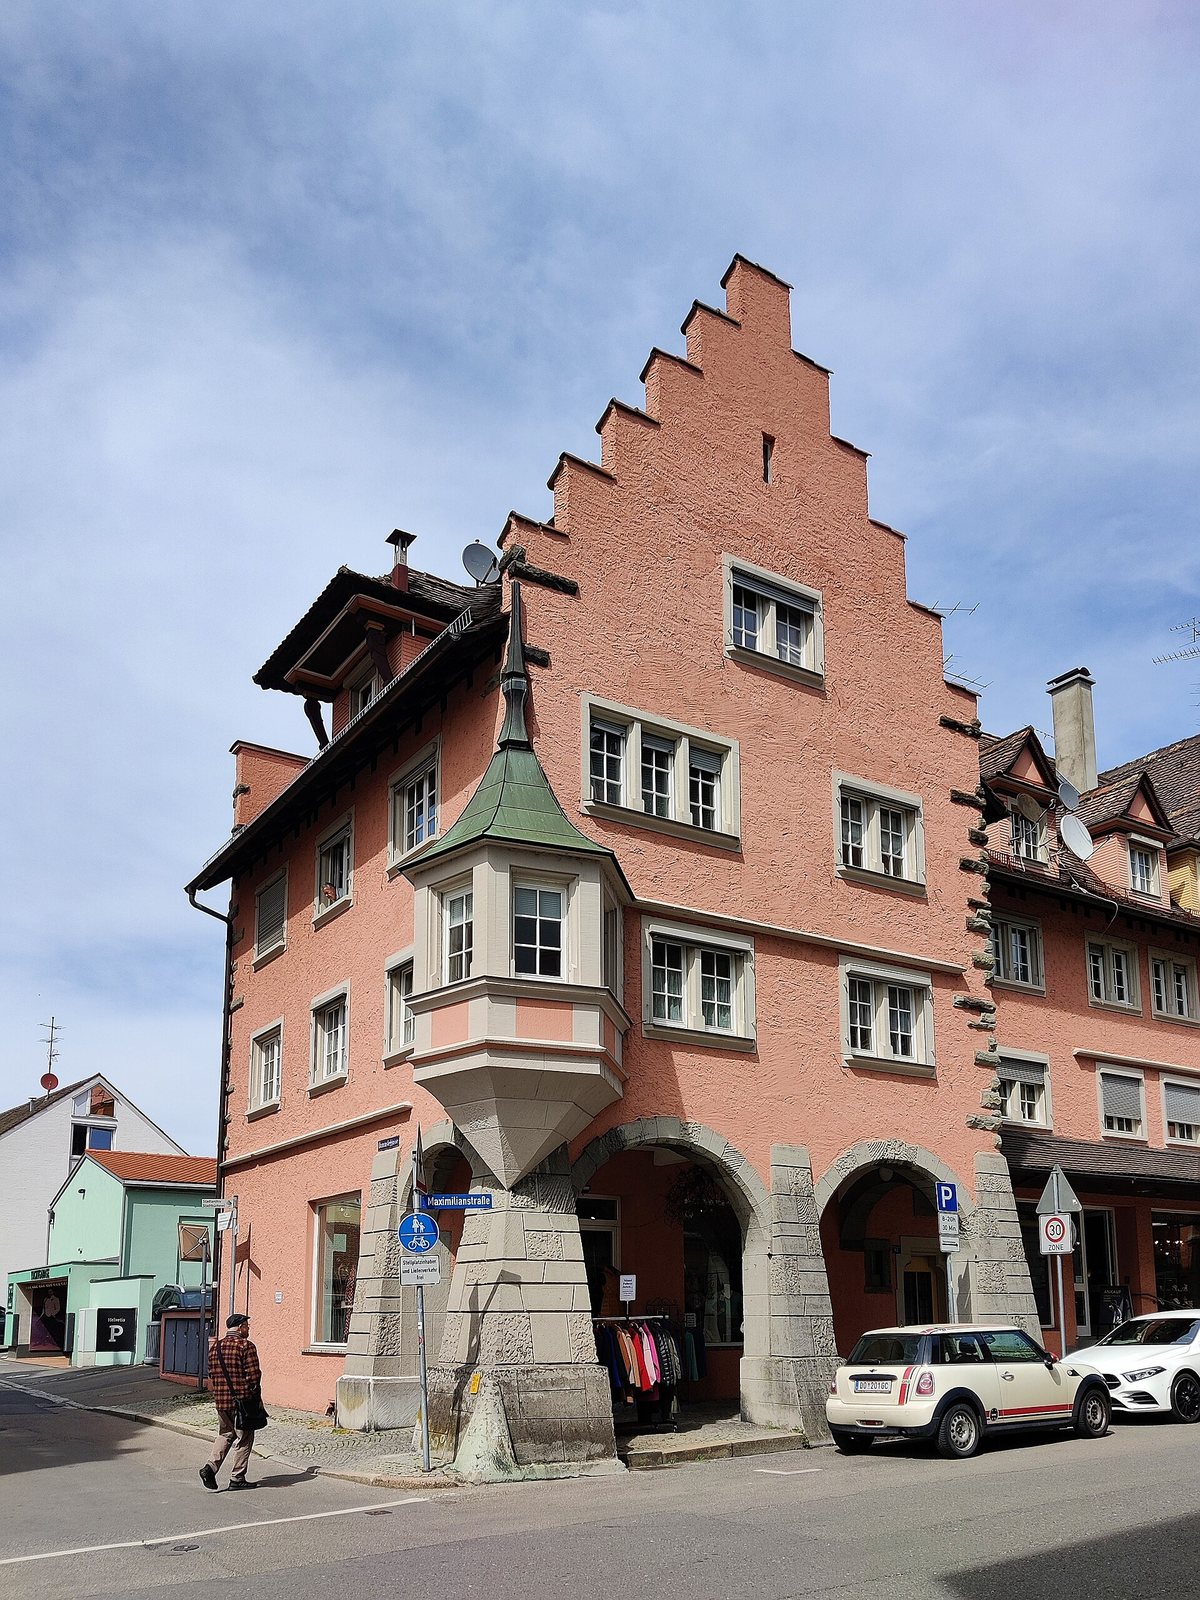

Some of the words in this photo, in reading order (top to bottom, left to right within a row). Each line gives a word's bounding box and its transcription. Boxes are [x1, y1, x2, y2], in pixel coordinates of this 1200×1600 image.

[427, 1195, 490, 1206] Maximilianstraße
[941, 1185, 953, 1208] P
[1049, 1224, 1062, 1236] 30
[108, 1324, 124, 1342] P
